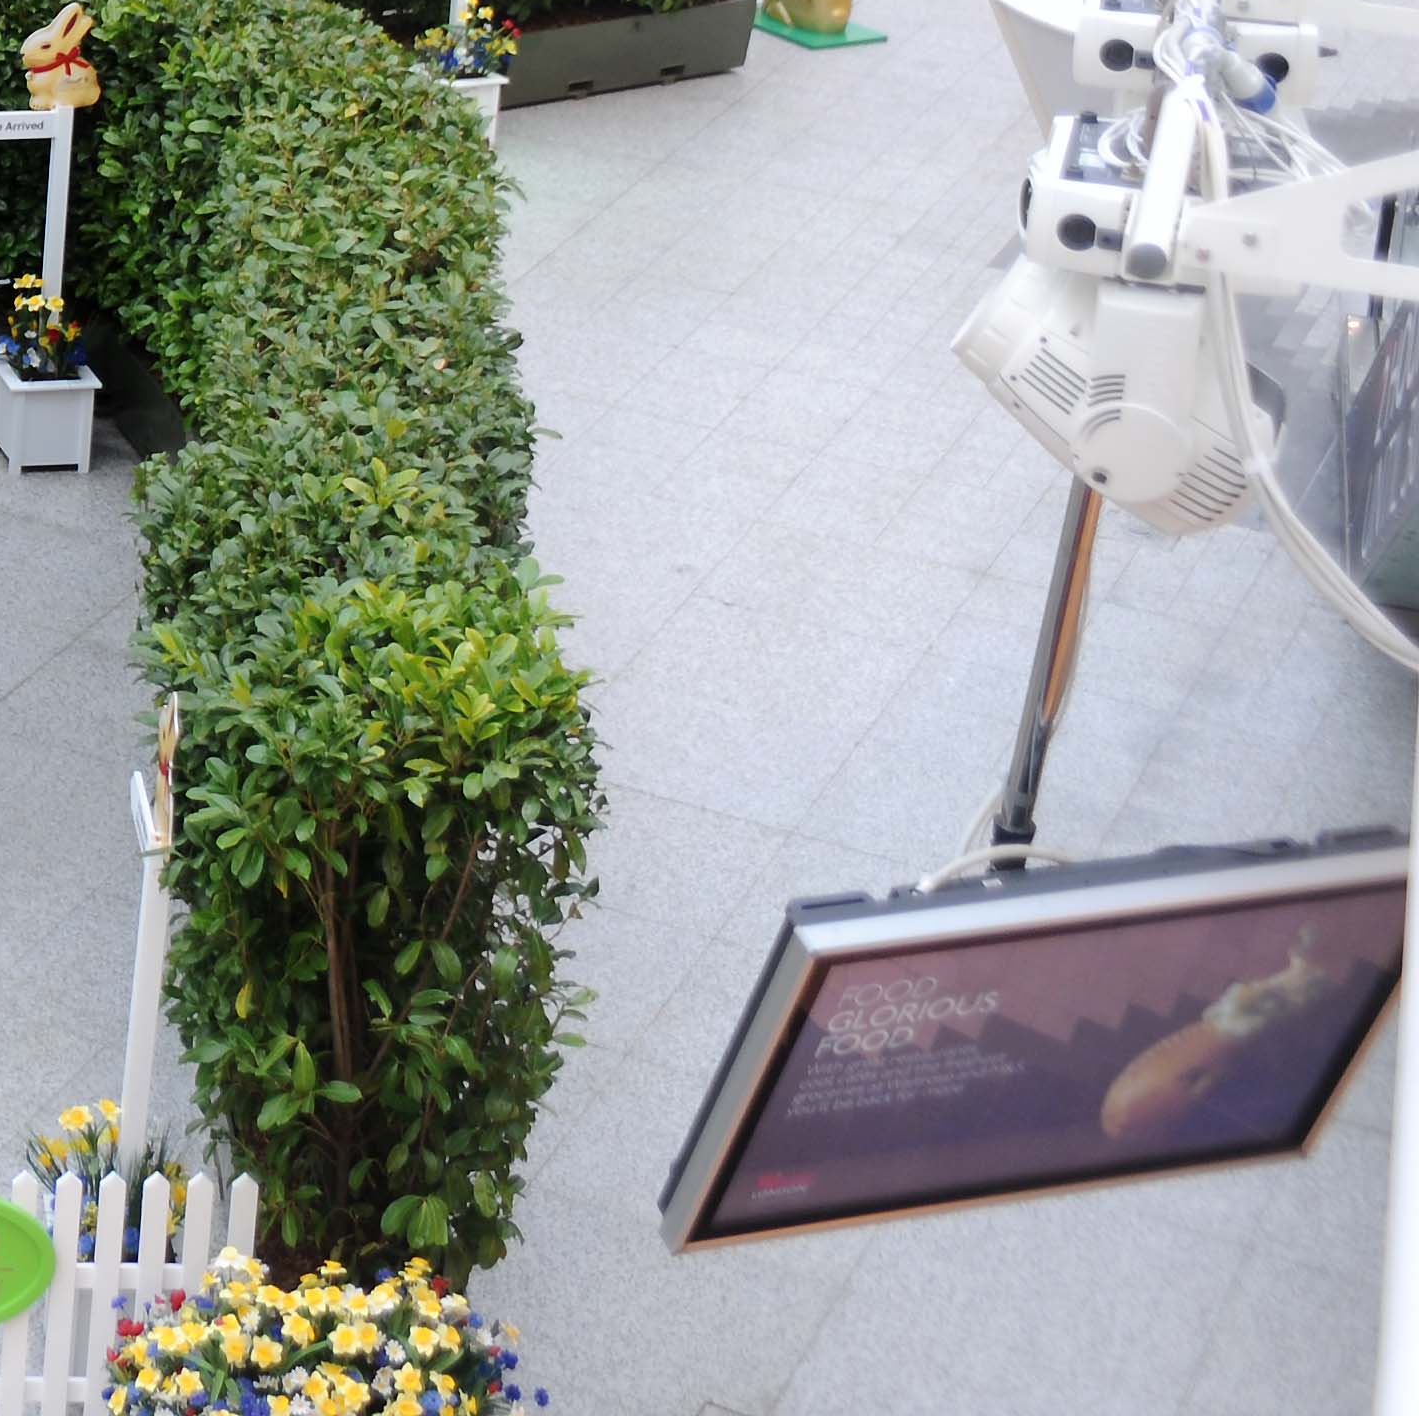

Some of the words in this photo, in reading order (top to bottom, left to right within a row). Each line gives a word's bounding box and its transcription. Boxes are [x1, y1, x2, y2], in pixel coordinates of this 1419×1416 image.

[5, 121, 44, 132] Arrived
[837, 975, 939, 1009] FOOD
[828, 990, 1000, 1034] GLORIOUS
[814, 1026, 915, 1059] FOOD
